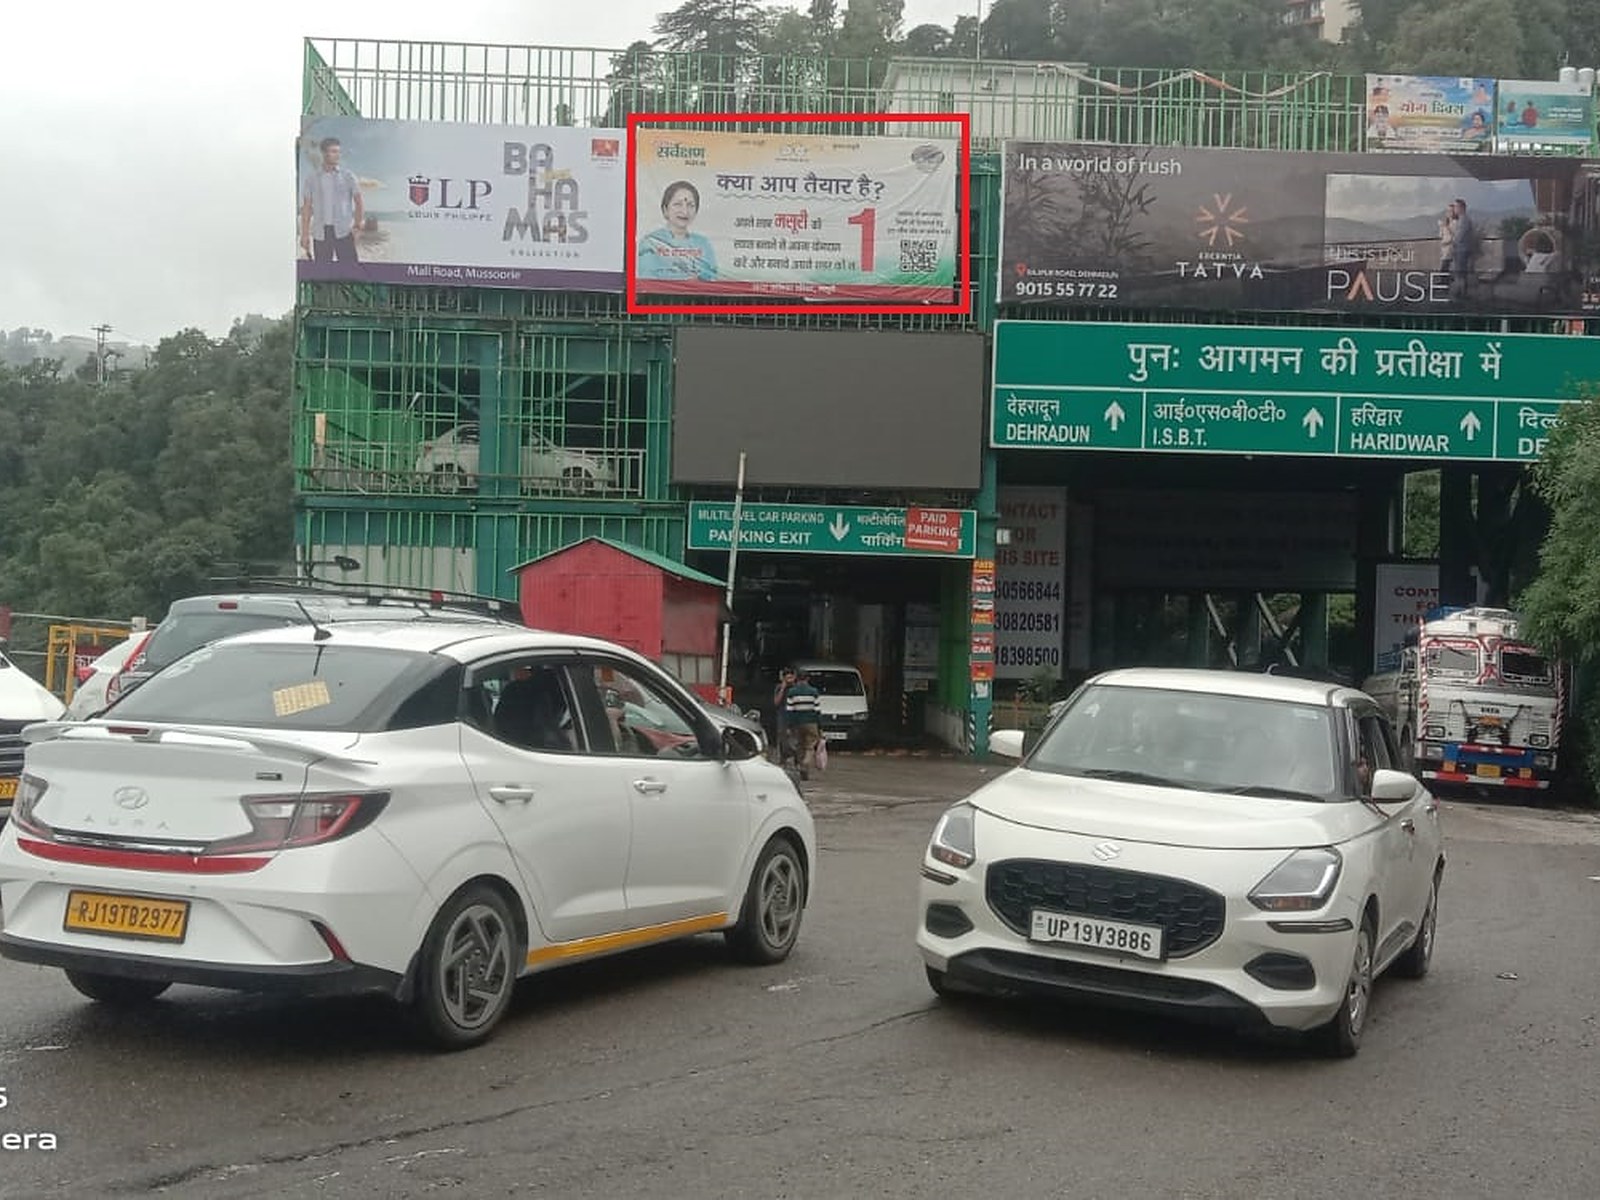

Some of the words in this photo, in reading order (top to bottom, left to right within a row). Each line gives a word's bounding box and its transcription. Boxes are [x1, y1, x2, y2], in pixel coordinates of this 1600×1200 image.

[1019, 154, 1037, 171] In
[1042, 158, 1053, 172] a
[1056, 155, 1110, 174] world
[1116, 156, 1136, 174] of
[1139, 158, 1182, 176] rush
[435, 178, 493, 210] LP
[716, 174, 754, 191] क्या
[761, 176, 798, 192] आप
[803, 172, 853, 195] तैयार
[848, 207, 875, 272] 1
[407, 265, 431, 277] Mall
[433, 267, 463, 279] Road,
[465, 267, 522, 280] Mussoorie
[1176, 261, 1264, 280] TATVA
[1016, 281, 1052, 297] 9015
[1056, 283, 1074, 297] 55
[1078, 284, 1095, 297] 77
[1098, 285, 1118, 298] 22
[1326, 270, 1449, 302] PAUSE
[1199, 345, 1303, 374] आगमन
[1320, 338, 1357, 375] की
[1375, 339, 1463, 379] प्रतीक्षा
[1479, 342, 1502, 380] में
[1006, 393, 1060, 420] देहरादून
[1351, 402, 1403, 427] हरिद्वार
[1006, 423, 1090, 443] DEHRADUN
[1153, 428, 1208, 447] I.S.B.T.
[1351, 433, 1450, 452] HARIDWAR
[699, 509, 756, 522] MULTILVEL
[759, 511, 780, 523] CAR
[781, 512, 824, 525] PARKING
[920, 511, 946, 524] PAID
[779, 531, 812, 545] EXIT
[908, 523, 958, 538] PARKING
[78, 902, 182, 934] RJ19TB2977
[1049, 918, 1151, 952] UP19V3886
